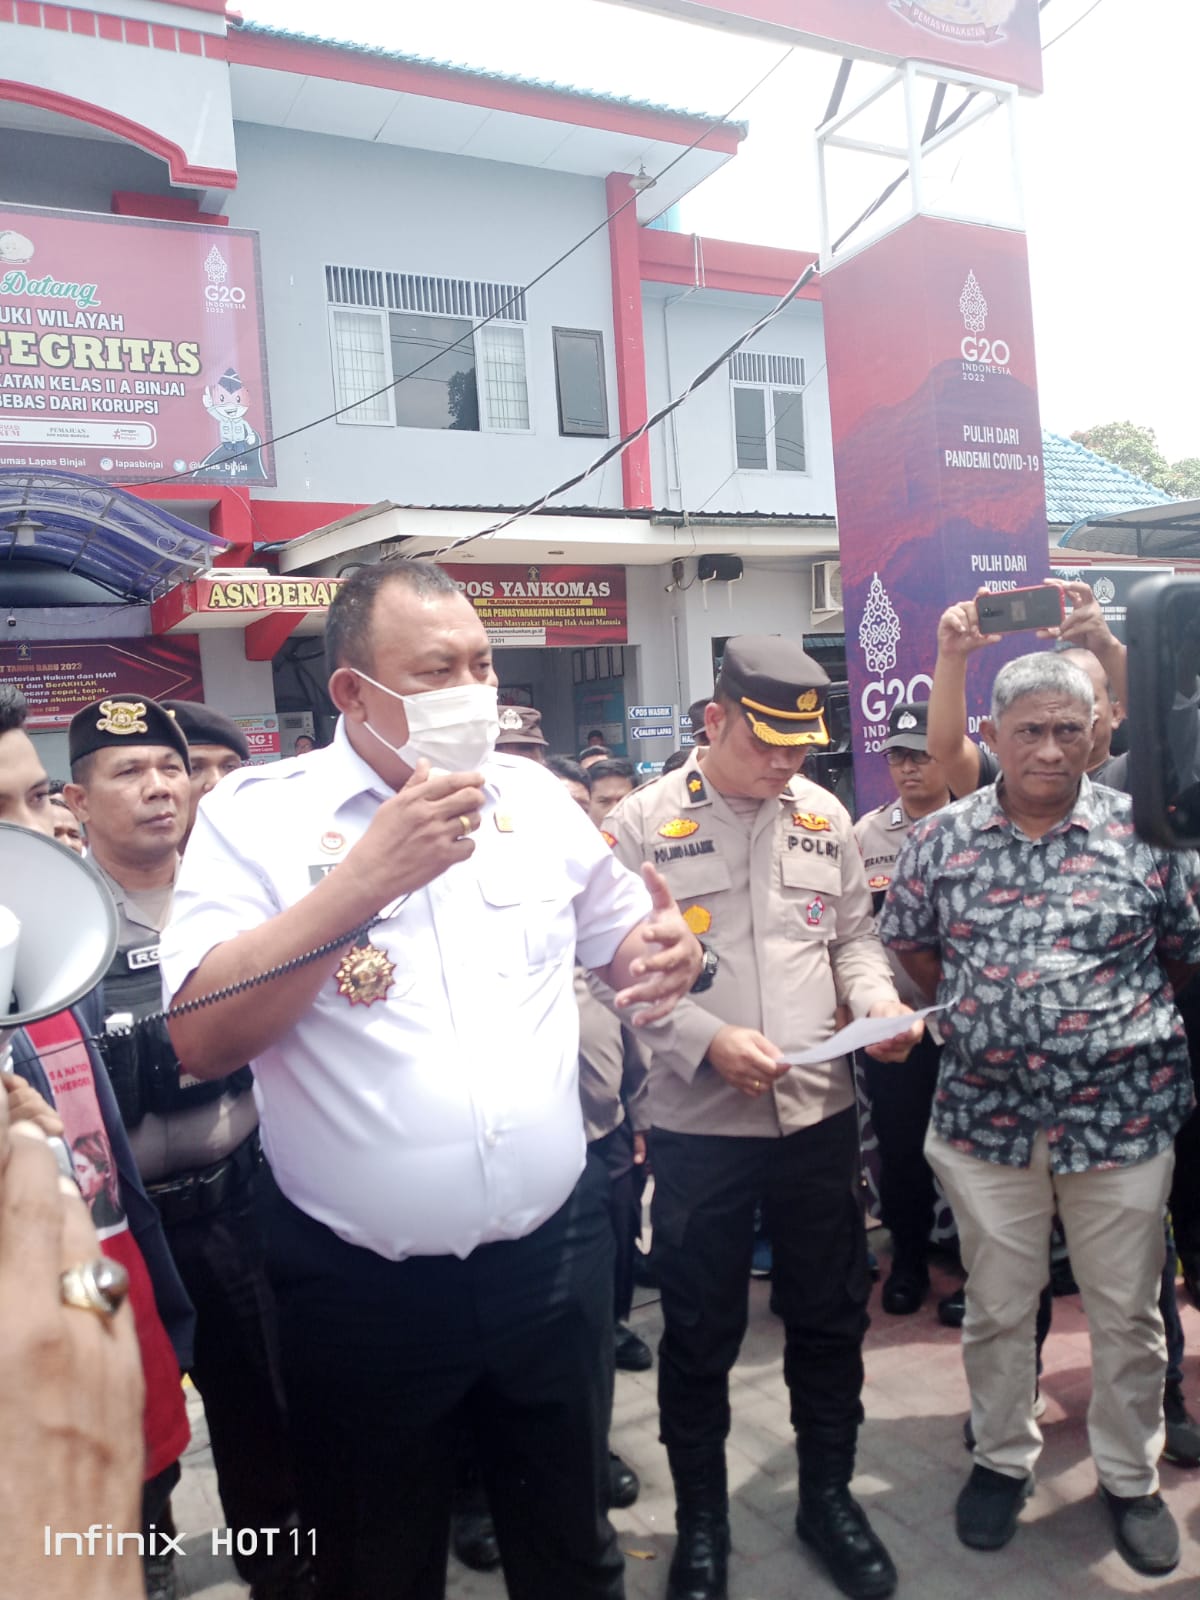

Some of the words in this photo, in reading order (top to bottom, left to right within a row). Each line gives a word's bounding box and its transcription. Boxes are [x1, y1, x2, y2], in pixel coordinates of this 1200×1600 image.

[913, 8, 985, 37] PEMASYARAKATAN
[0, 270, 101, 309] Datang
[205, 285, 246, 303] G20
[205, 301, 246, 310] INDONESIA
[37, 309, 124, 331] WILAYAH
[961, 336, 1010, 365] G20
[962, 362, 1012, 375] INDONESIA
[962, 372, 985, 382] 2022
[50, 375, 101, 392] KELAS
[106, 381, 115, 393] II
[120, 381, 131, 394] A
[135, 382, 185, 397] BINJAI
[50, 395, 87, 411] DARI
[92, 398, 159, 414] KORUPSI
[963, 425, 994, 443] PULIH
[996, 427, 1019, 445] DARI
[29, 457, 57, 467] Lapas
[60, 457, 86, 467] Binjai
[116, 458, 163, 469] lapasbinjai
[945, 450, 991, 469] PANDEMI
[993, 453, 1039, 471] COVID-19
[971, 554, 1002, 572] PULIH
[1004, 554, 1027, 572] DARI
[208, 582, 259, 607] ASN
[454, 581, 494, 597] POS
[500, 581, 610, 597] YANKOMAS
[493, 608, 554, 617] PEMASYARAKATAN
[555, 608, 575, 617] KELAS
[505, 619, 540, 628] Masyarakat
[596, 617, 621, 625] Manusia
[60, 662, 82, 671] 2023
[43, 673, 75, 681] Hukum
[95, 671, 117, 679] HAM
[45, 680, 97, 689] BerAKHLAK
[50, 695, 96, 703] akuntabel
[635, 708, 648, 717] POS
[639, 728, 656, 737] GALERI
[657, 727, 672, 735] LAPAS
[863, 724, 891, 738] IND
[788, 835, 838, 860] POLRI
